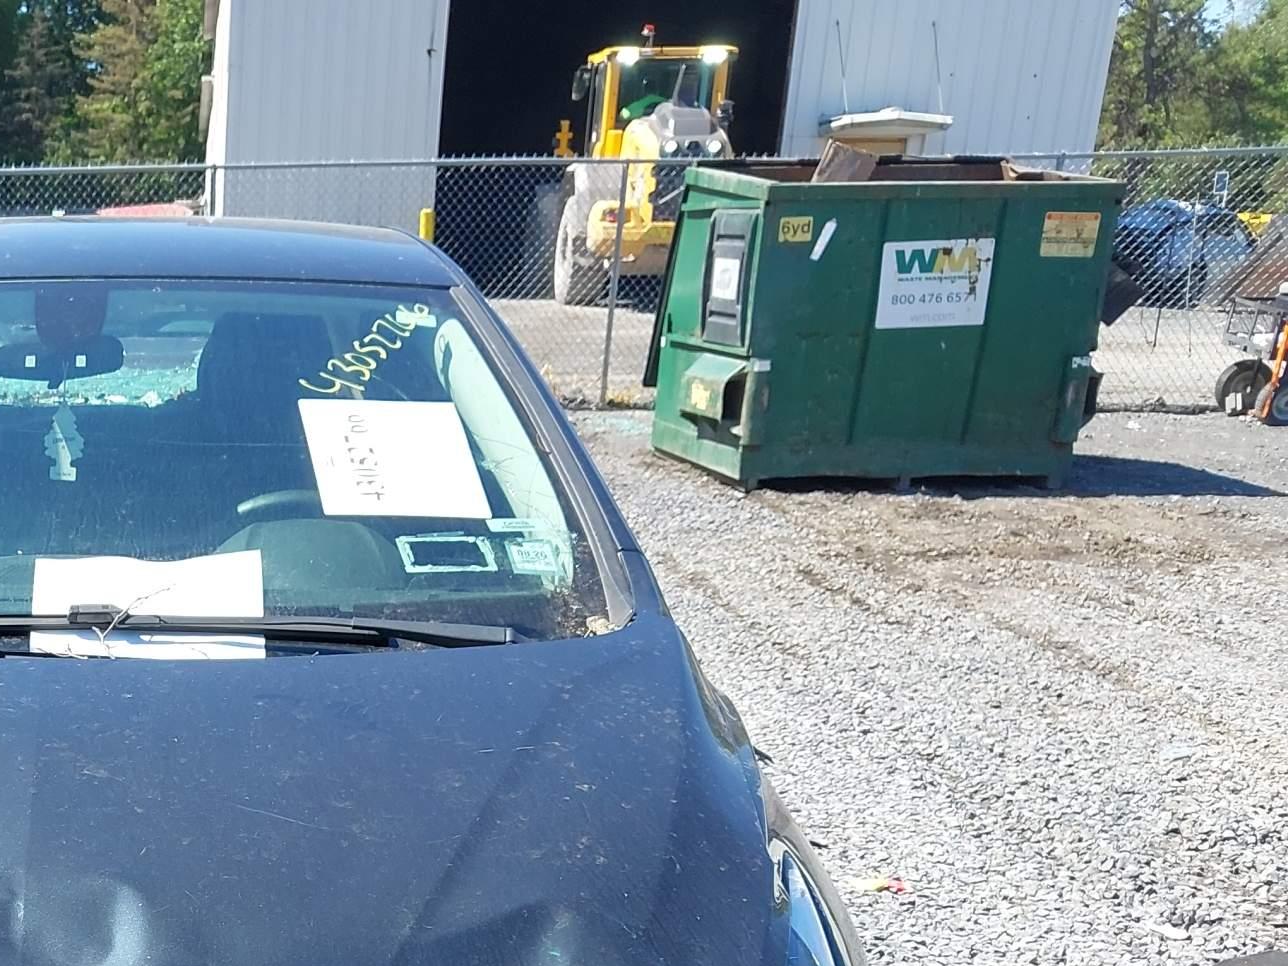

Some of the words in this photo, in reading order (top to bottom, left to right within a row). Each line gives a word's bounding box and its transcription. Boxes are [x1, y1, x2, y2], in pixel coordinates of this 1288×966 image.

[781, 220, 811, 237] 6yd
[895, 247, 977, 274] WM
[891, 294, 915, 305] 800
[918, 293, 943, 304] 476
[298, 303, 430, 393] 43052766
